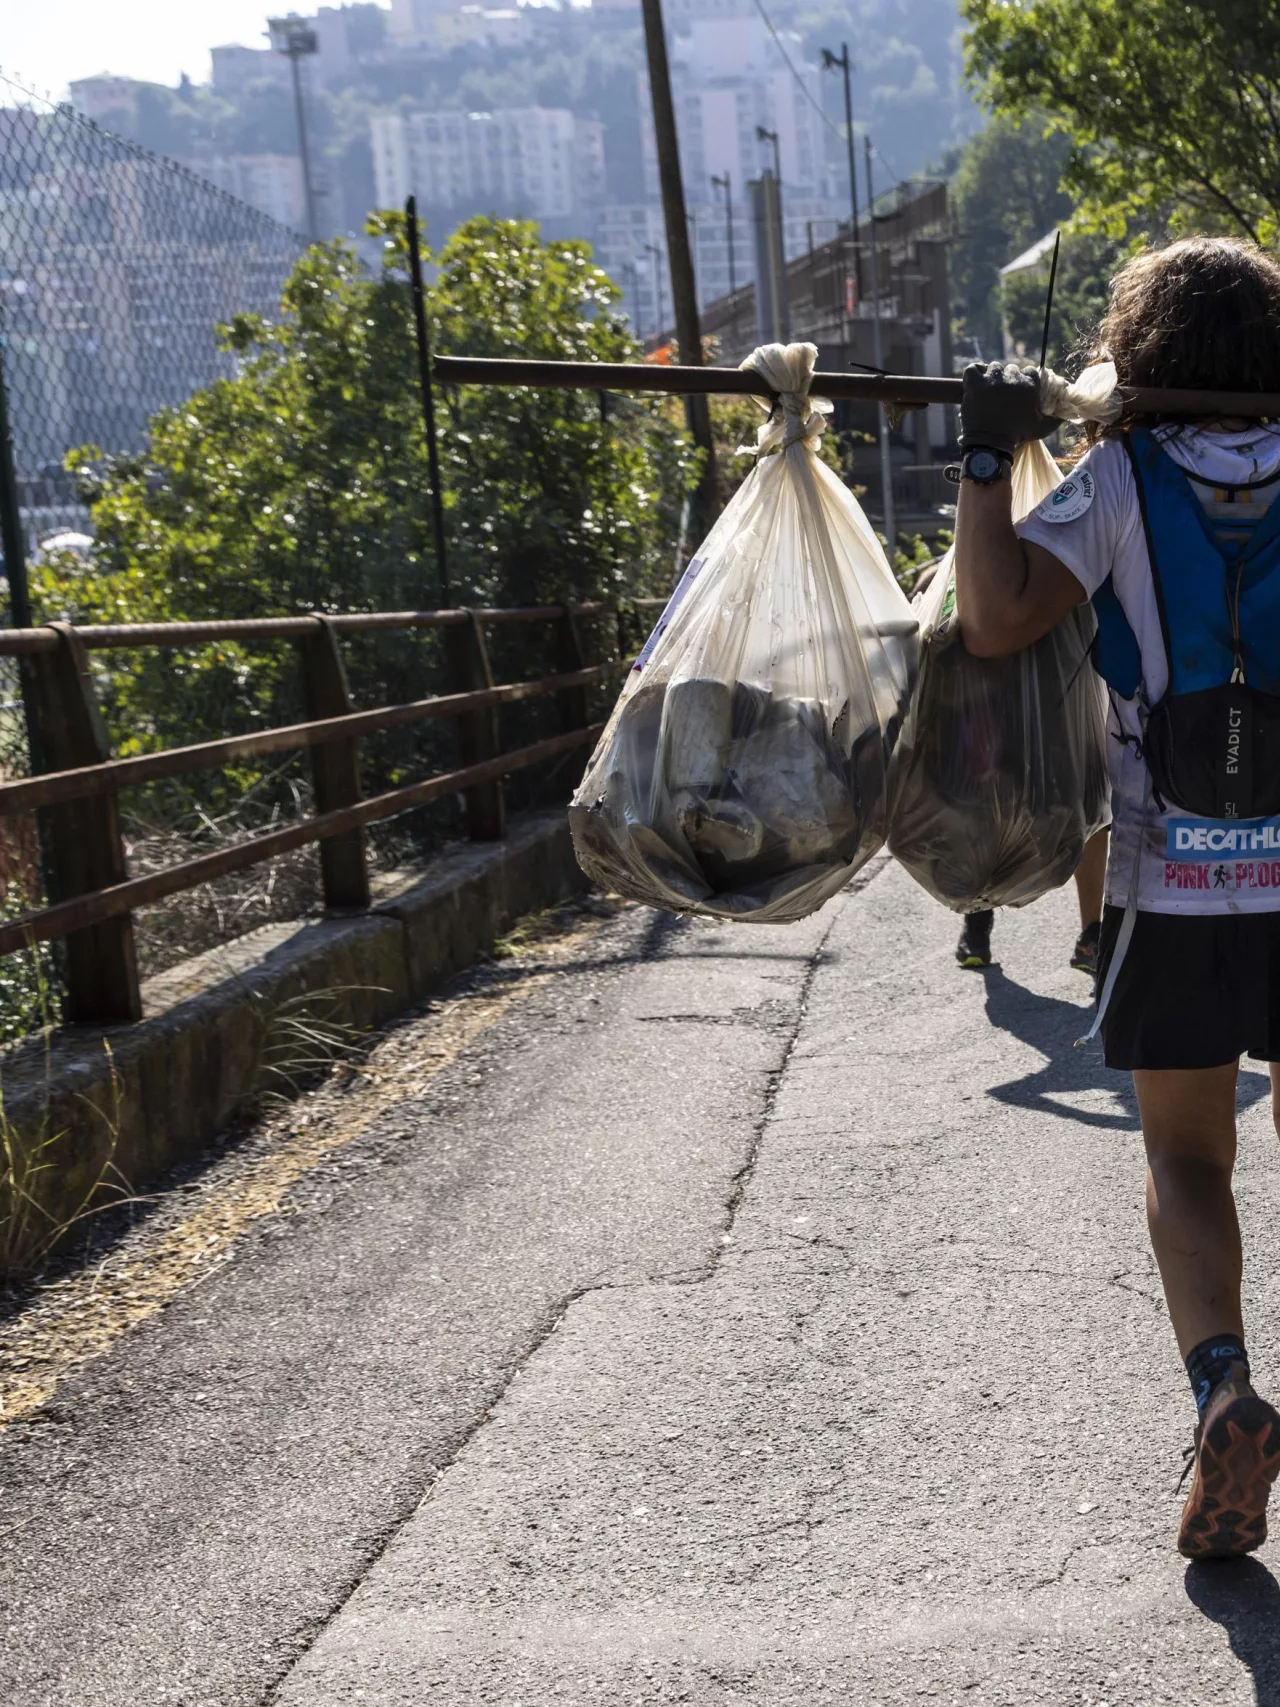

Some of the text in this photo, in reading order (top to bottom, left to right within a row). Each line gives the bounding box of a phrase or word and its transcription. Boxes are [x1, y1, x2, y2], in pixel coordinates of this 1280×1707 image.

[1081, 473, 1093, 498] District
[1064, 507, 1082, 519] SKATE
[1226, 707, 1242, 774] EVADICT
[1164, 862, 1211, 889] PINK
